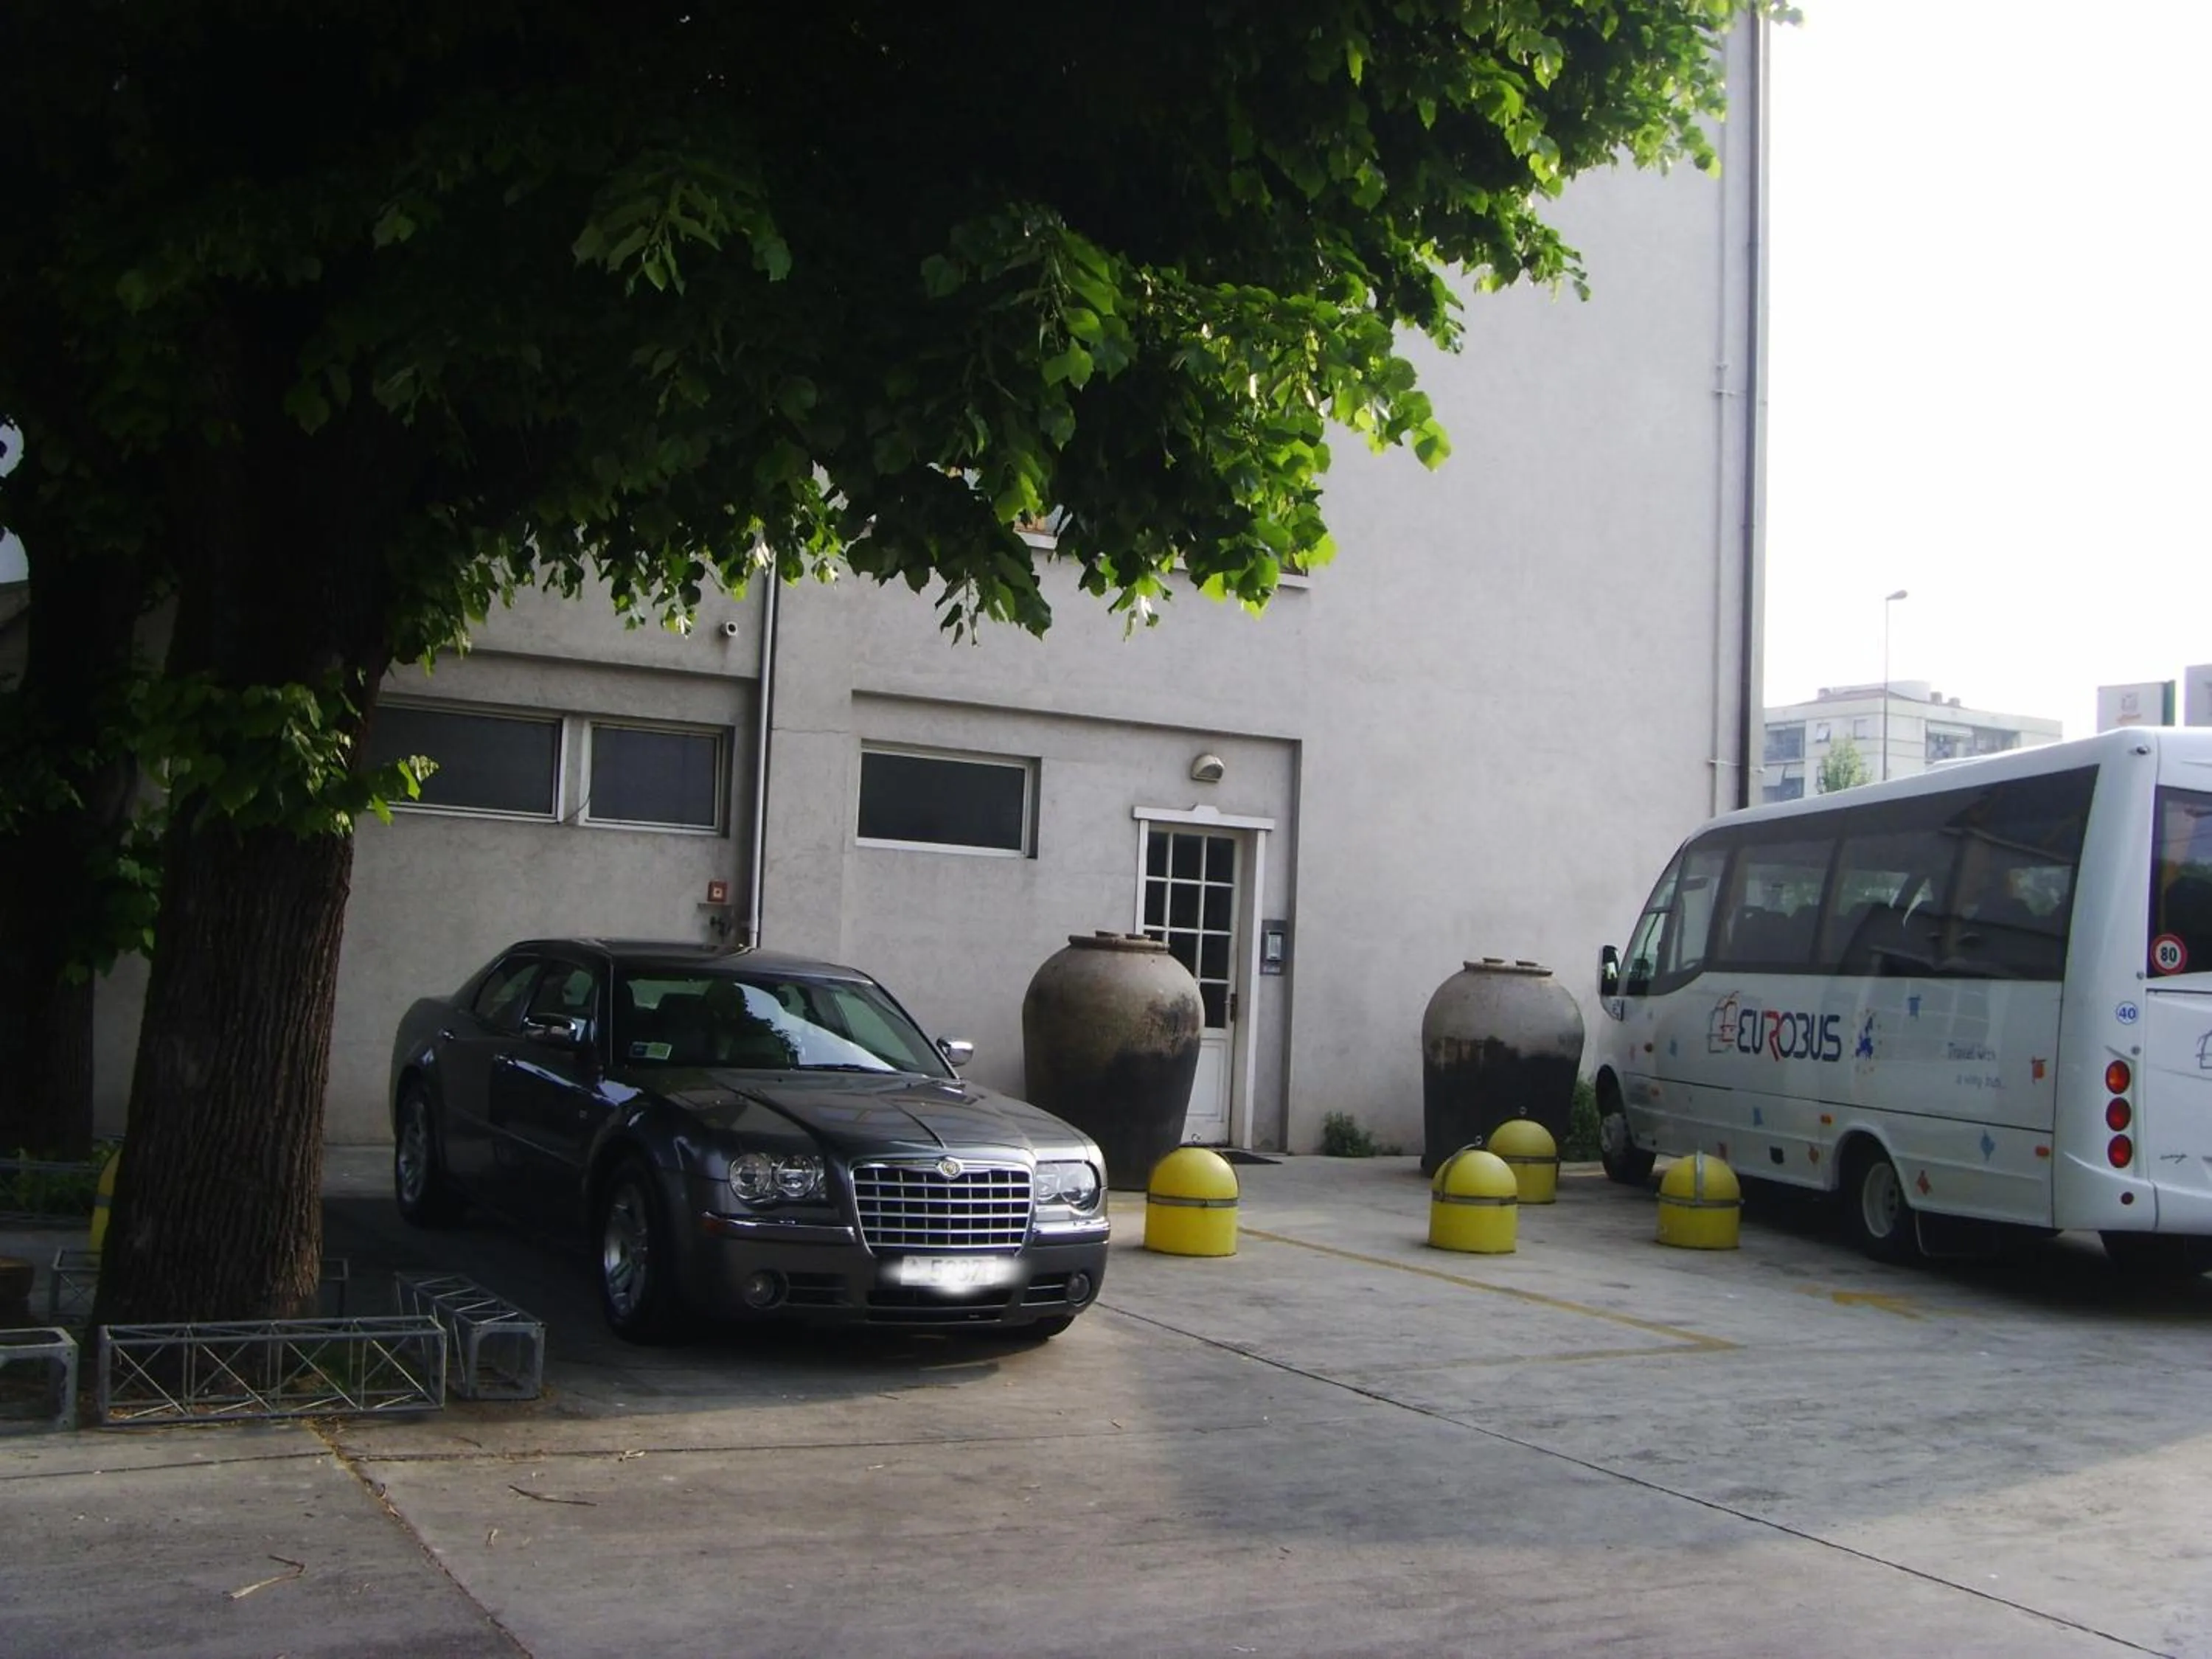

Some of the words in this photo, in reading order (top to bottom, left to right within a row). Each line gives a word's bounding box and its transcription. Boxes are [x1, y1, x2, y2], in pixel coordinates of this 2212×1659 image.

[2160, 946, 2178, 963] 80
[2118, 1006, 2137, 1020] 40
[1736, 1008, 1843, 1062] EUROBUS
